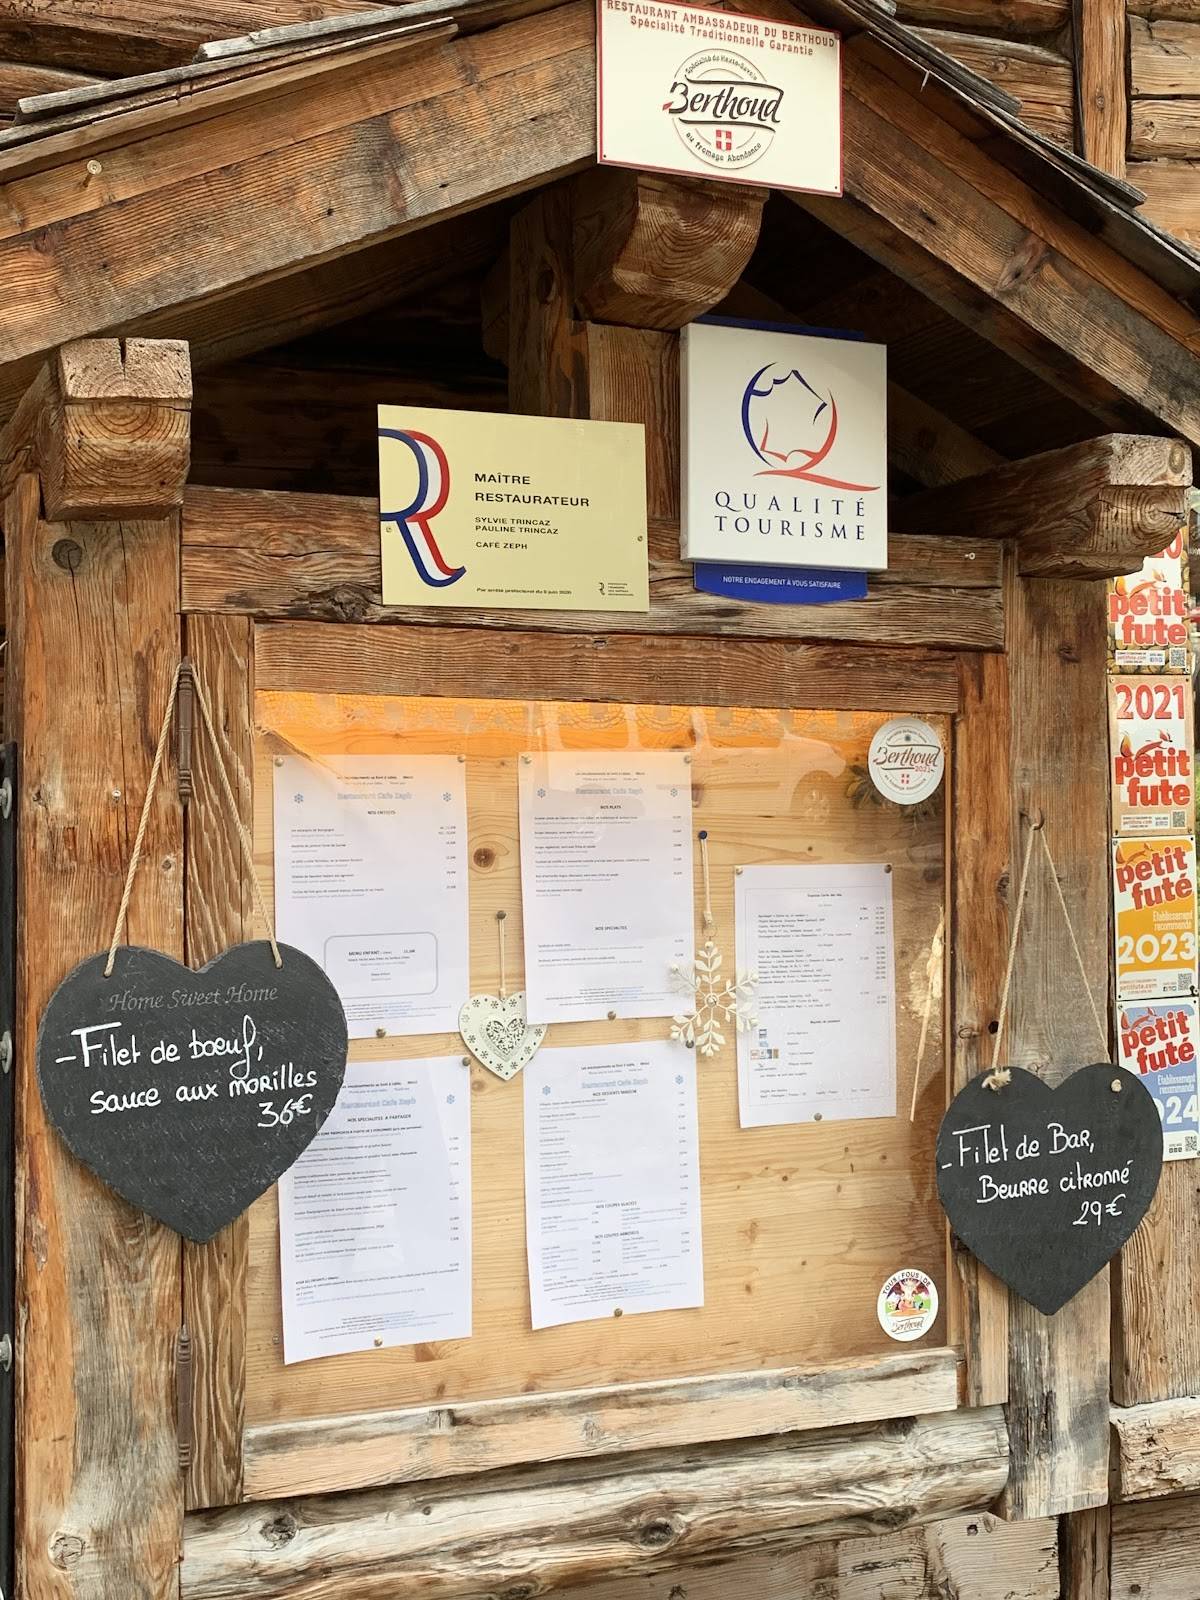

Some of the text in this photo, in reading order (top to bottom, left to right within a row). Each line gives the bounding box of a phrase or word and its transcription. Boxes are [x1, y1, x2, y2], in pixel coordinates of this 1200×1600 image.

[607, 0, 835, 48] RESTAURANT AMBASSADEUR DU BERTHOUD
[630, 16, 813, 56] Spécialité Traditionnelle Garantie
[662, 81, 781, 123] Berthoud
[686, 132, 762, 162] au fromage Abondance
[474, 472, 531, 485] MAÎTRE
[475, 492, 590, 506] RESTAURATEUR
[715, 491, 865, 517] QUALITÉ
[475, 517, 550, 526] SYLVIE TRINCAZ
[519, 527, 558, 535] TRINCAZ
[715, 515, 865, 540] TOURISME
[503, 542, 528, 550] ZEPH
[723, 576, 744, 584] NOTRE
[744, 577, 786, 586] ENGAGEMENT
[792, 579, 808, 587] VOUS
[809, 580, 841, 589] SATISFAIRE
[1109, 587, 1186, 622] petit
[1115, 684, 1185, 720] 2021
[873, 747, 938, 767] Berthoud
[1115, 747, 1190, 784] petit
[1116, 846, 1187, 892] petit
[1132, 873, 1192, 910] futé
[1118, 932, 1195, 964] 2023
[108, 984, 278, 1012] Home Sweet Home
[1121, 1011, 1190, 1058] petit
[150, 1040, 180, 1064] de
[1137, 1037, 1194, 1074] futé
[176, 1084, 218, 1102] aux
[257, 1094, 314, 1128] 36€
[1153, 1095, 1199, 1124] 24
[1016, 1135, 1040, 1160] de
[1073, 1193, 1126, 1225] 29€
[882, 1277, 898, 1294] TOUS
[922, 1278, 931, 1286] DE
